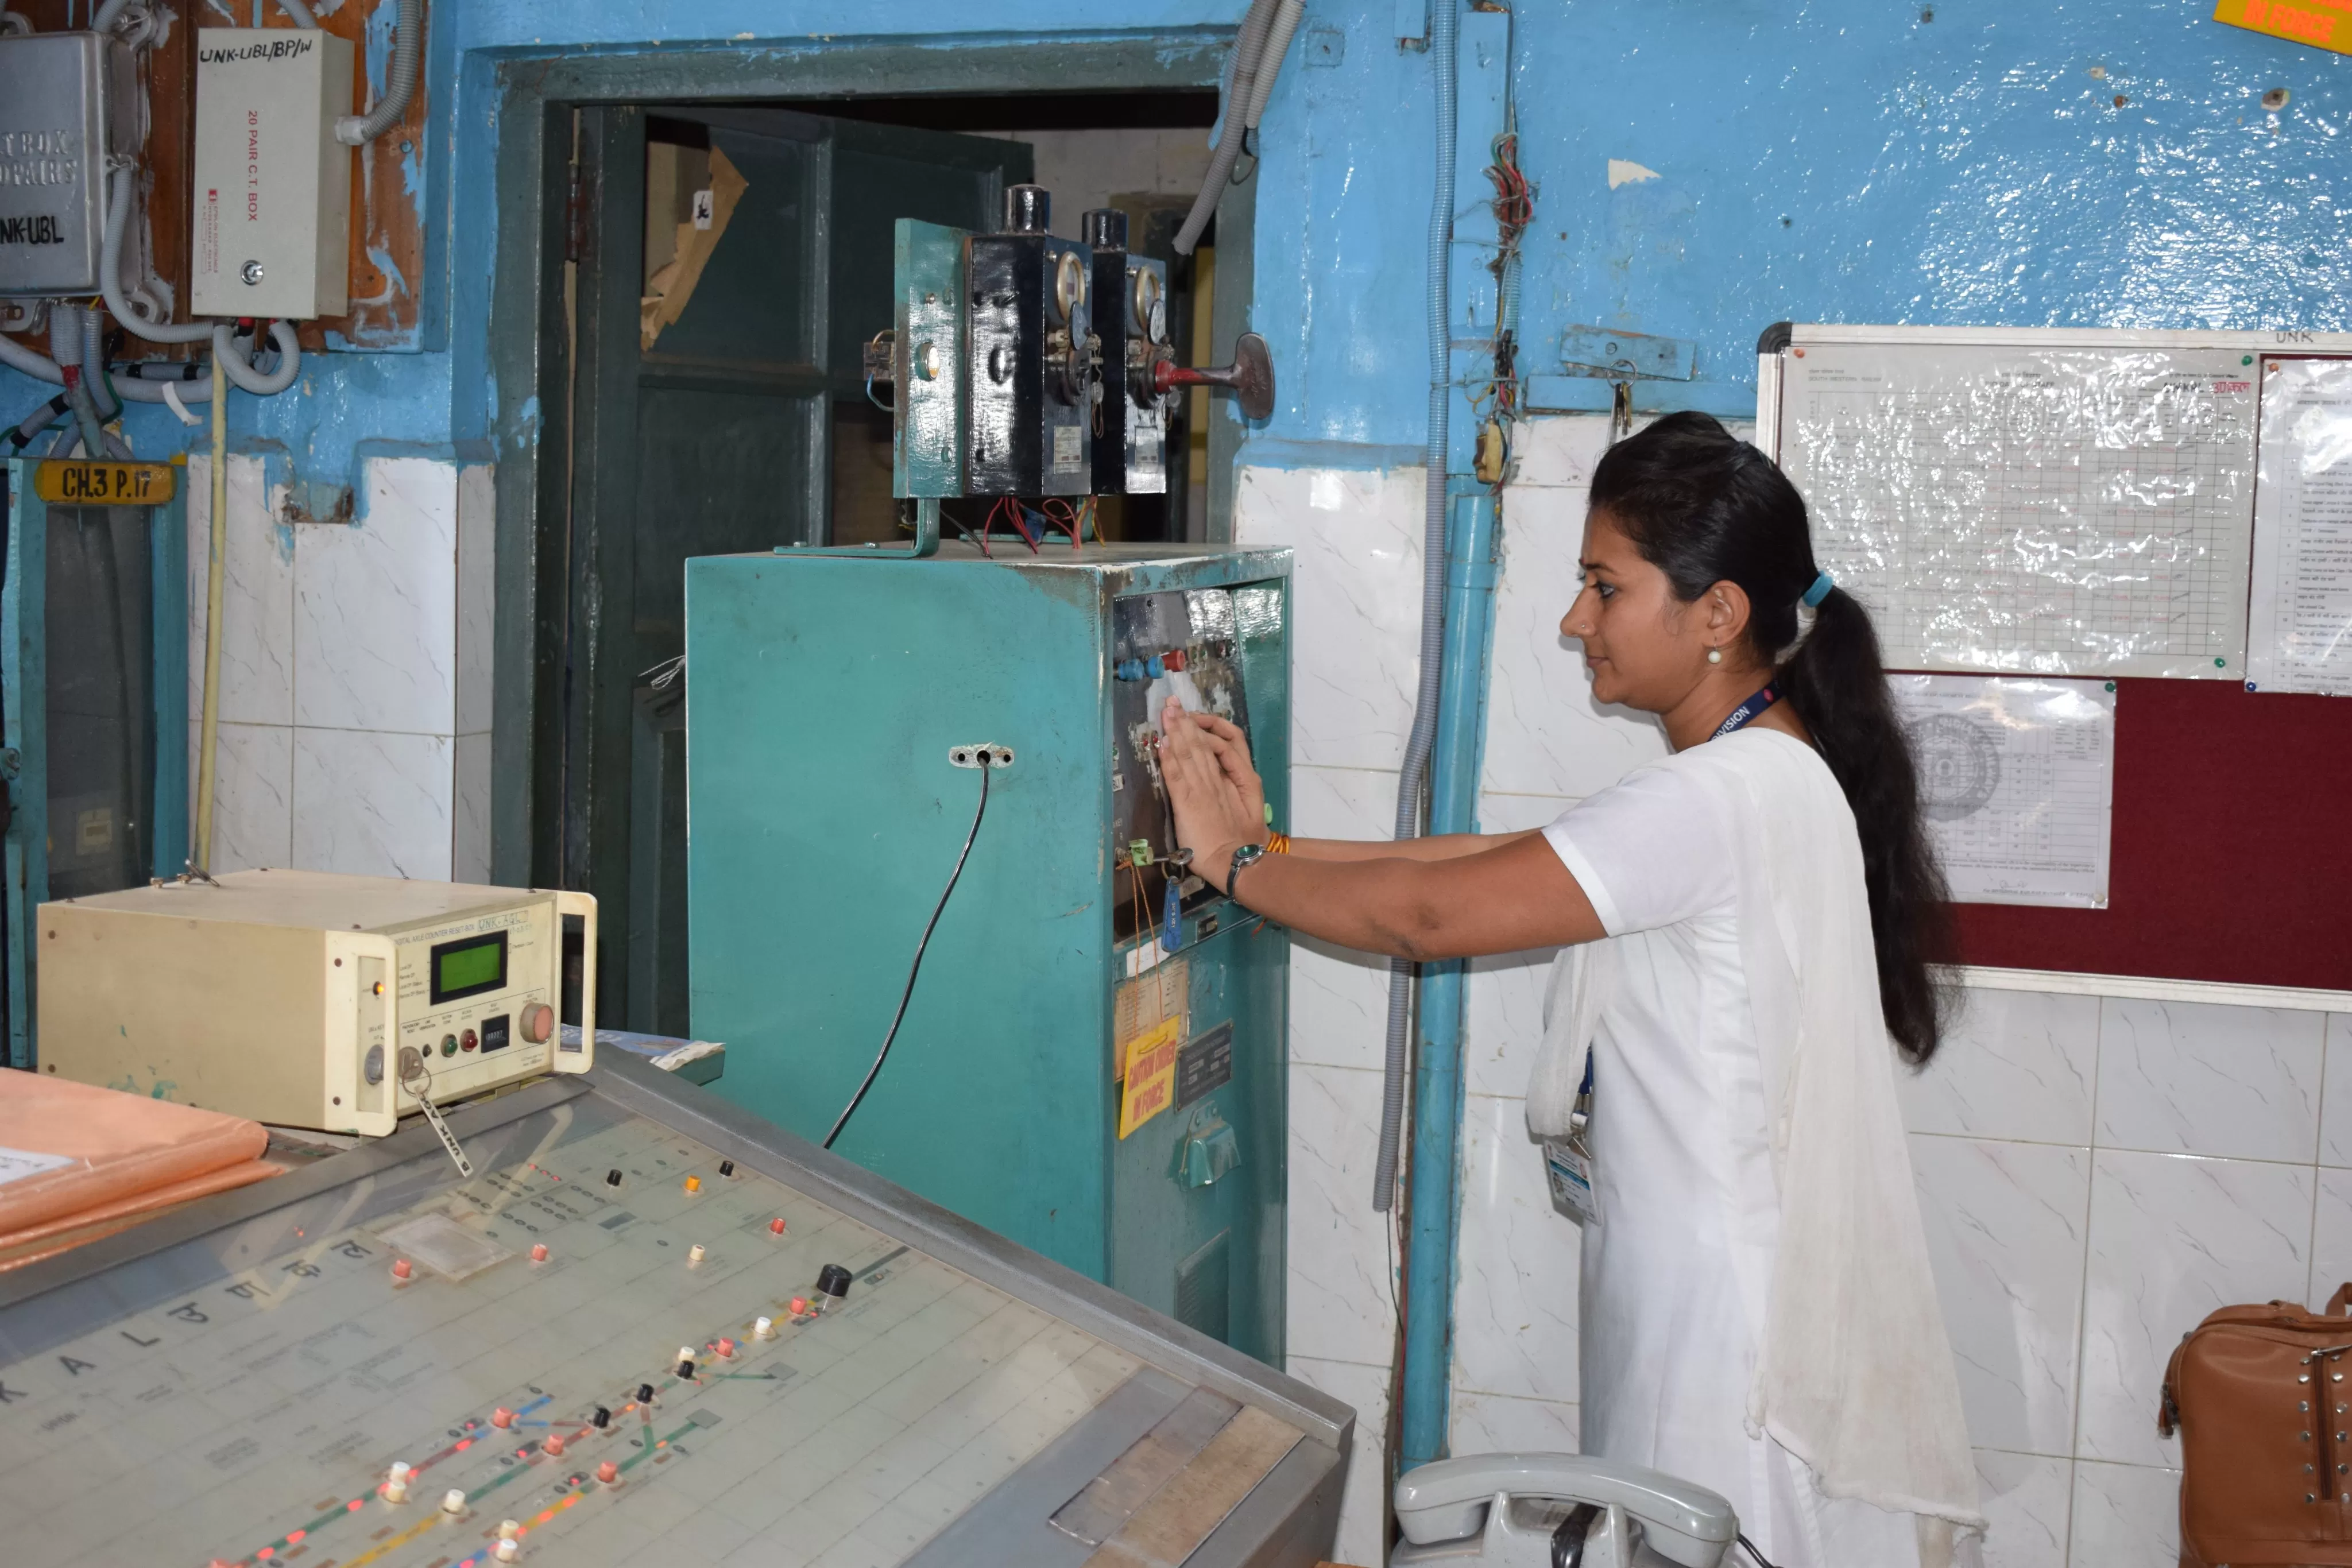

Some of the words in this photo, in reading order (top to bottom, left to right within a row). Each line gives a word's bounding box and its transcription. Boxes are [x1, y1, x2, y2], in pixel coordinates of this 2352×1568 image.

[2243, 0, 2268, 26] IN
[2268, 3, 2336, 42] FORCE
[248, 110, 258, 125] 20
[248, 130, 258, 161] PAIR
[248, 165, 258, 188] C.T.
[248, 192, 258, 222] BOX
[2276, 331, 2314, 343] UNK
